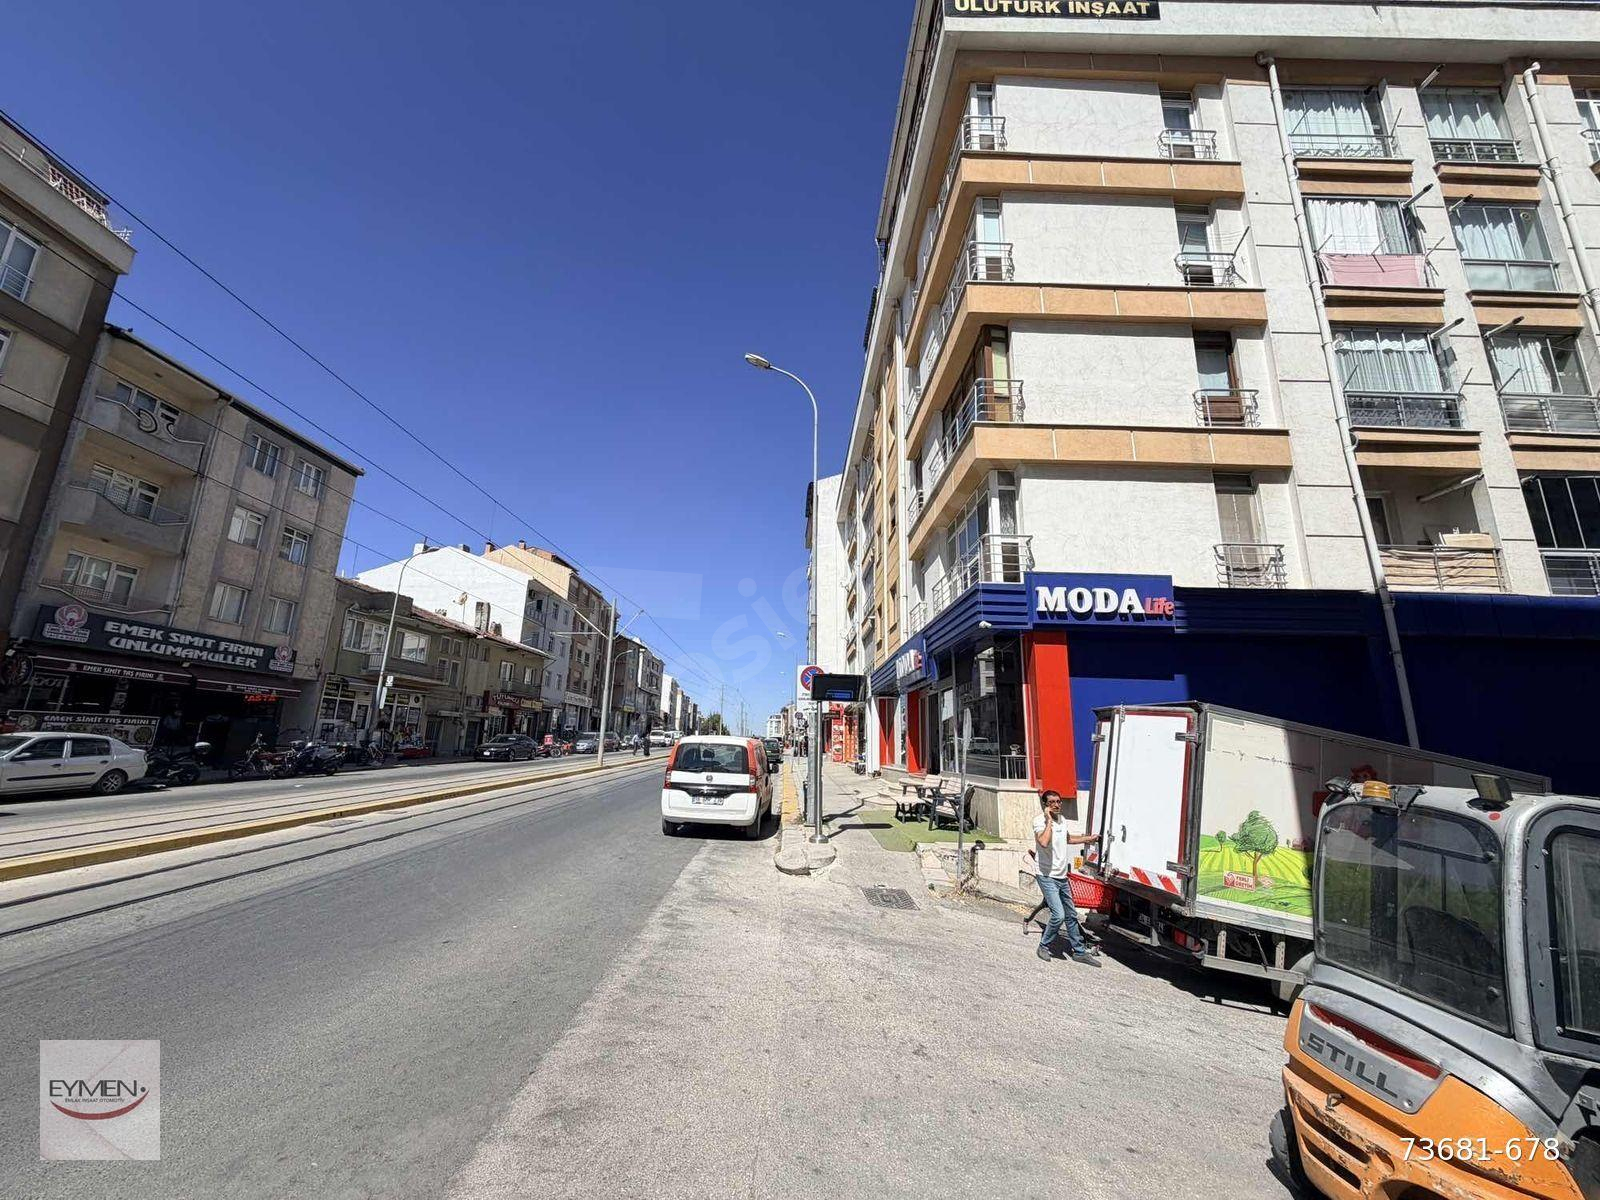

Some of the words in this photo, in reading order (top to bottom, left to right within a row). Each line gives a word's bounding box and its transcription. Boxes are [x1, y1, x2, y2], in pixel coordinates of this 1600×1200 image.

[1035, 586, 1145, 615] MODA
[1145, 597, 1175, 616] Life
[104, 620, 164, 642] EMEK
[219, 640, 265, 657] FIRINI
[83, 665, 102, 674] EMEK
[44, 714, 73, 723] EMEK
[1305, 1032, 1398, 1099] STILL
